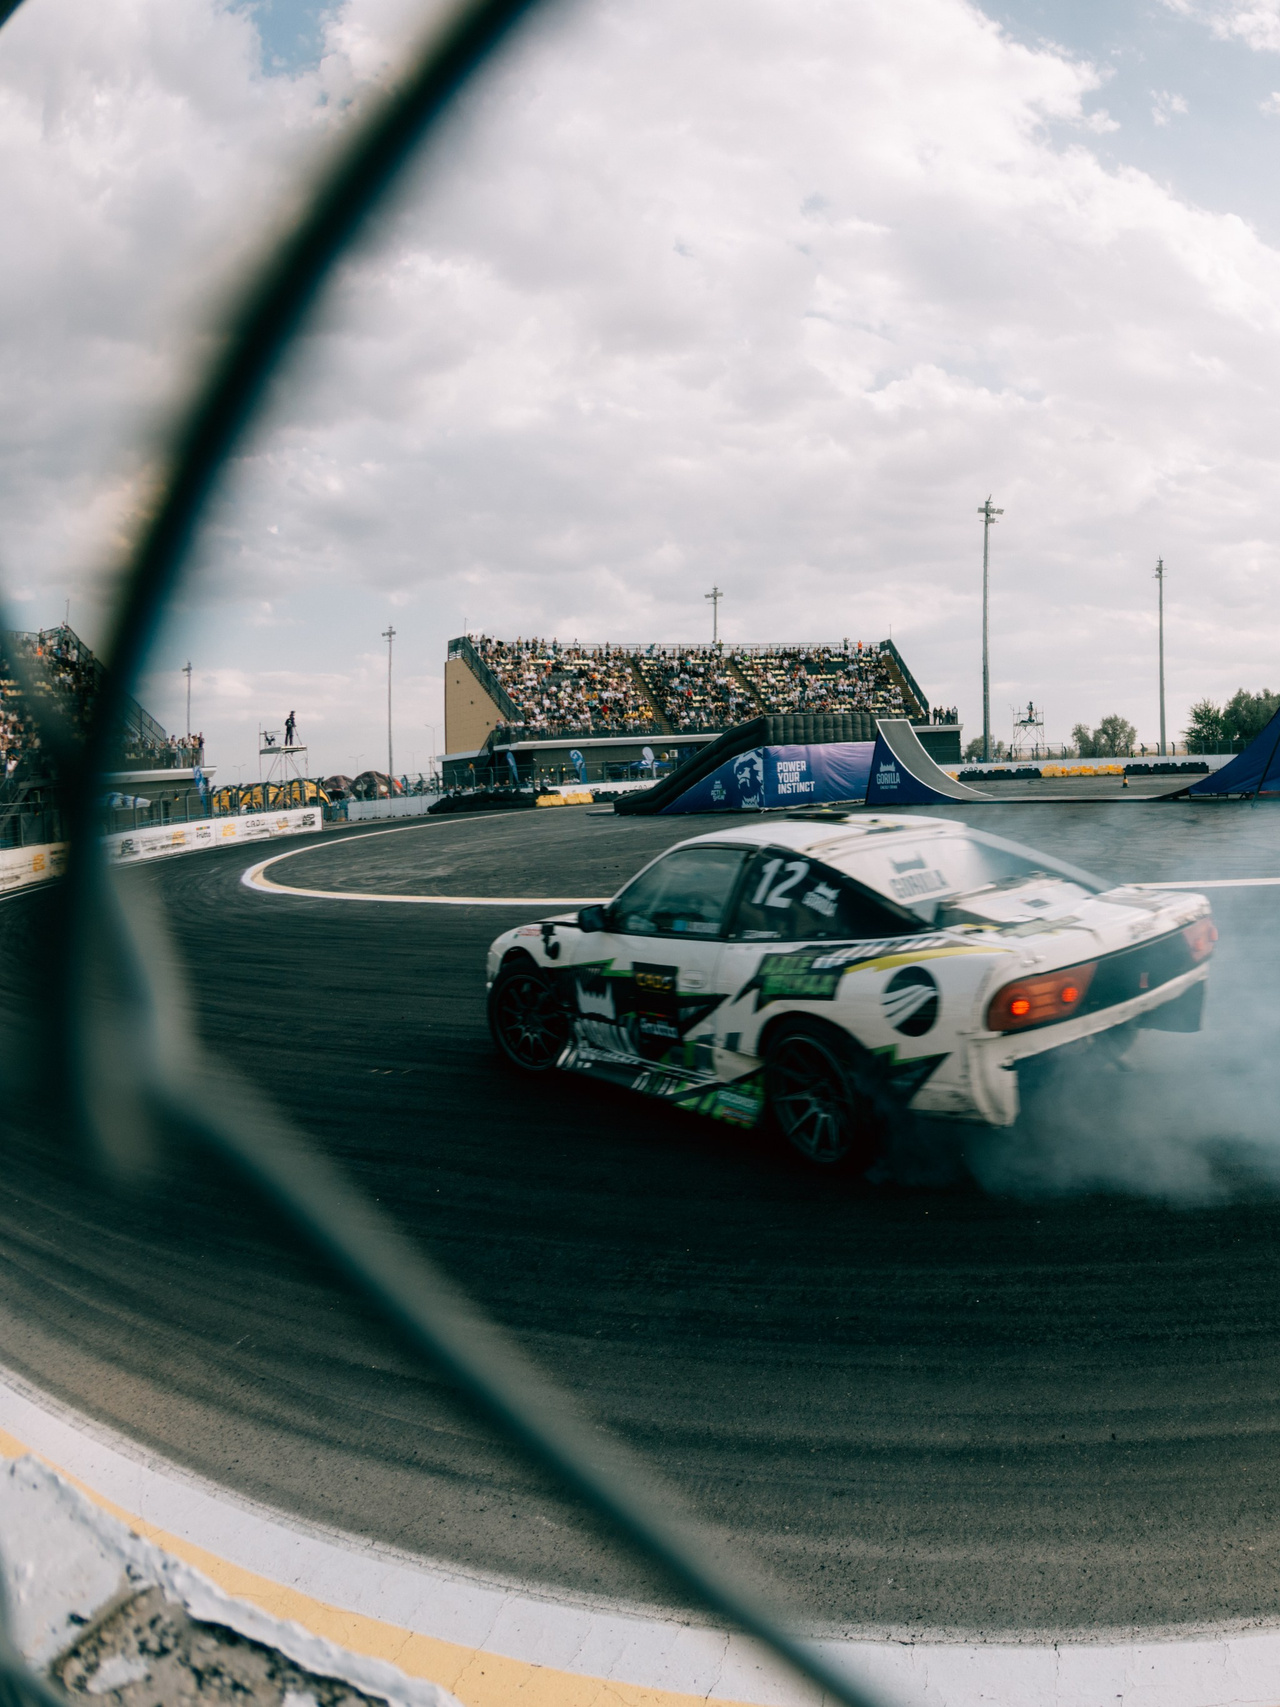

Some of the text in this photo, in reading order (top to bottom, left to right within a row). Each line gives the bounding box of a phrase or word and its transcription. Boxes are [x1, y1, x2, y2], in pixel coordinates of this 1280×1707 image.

[776, 760, 807, 773] POWER
[777, 772, 800, 784] YOUR
[876, 772, 901, 785] GORILLA
[777, 781, 816, 795] INSTINCT
[751, 858, 811, 909] 12
